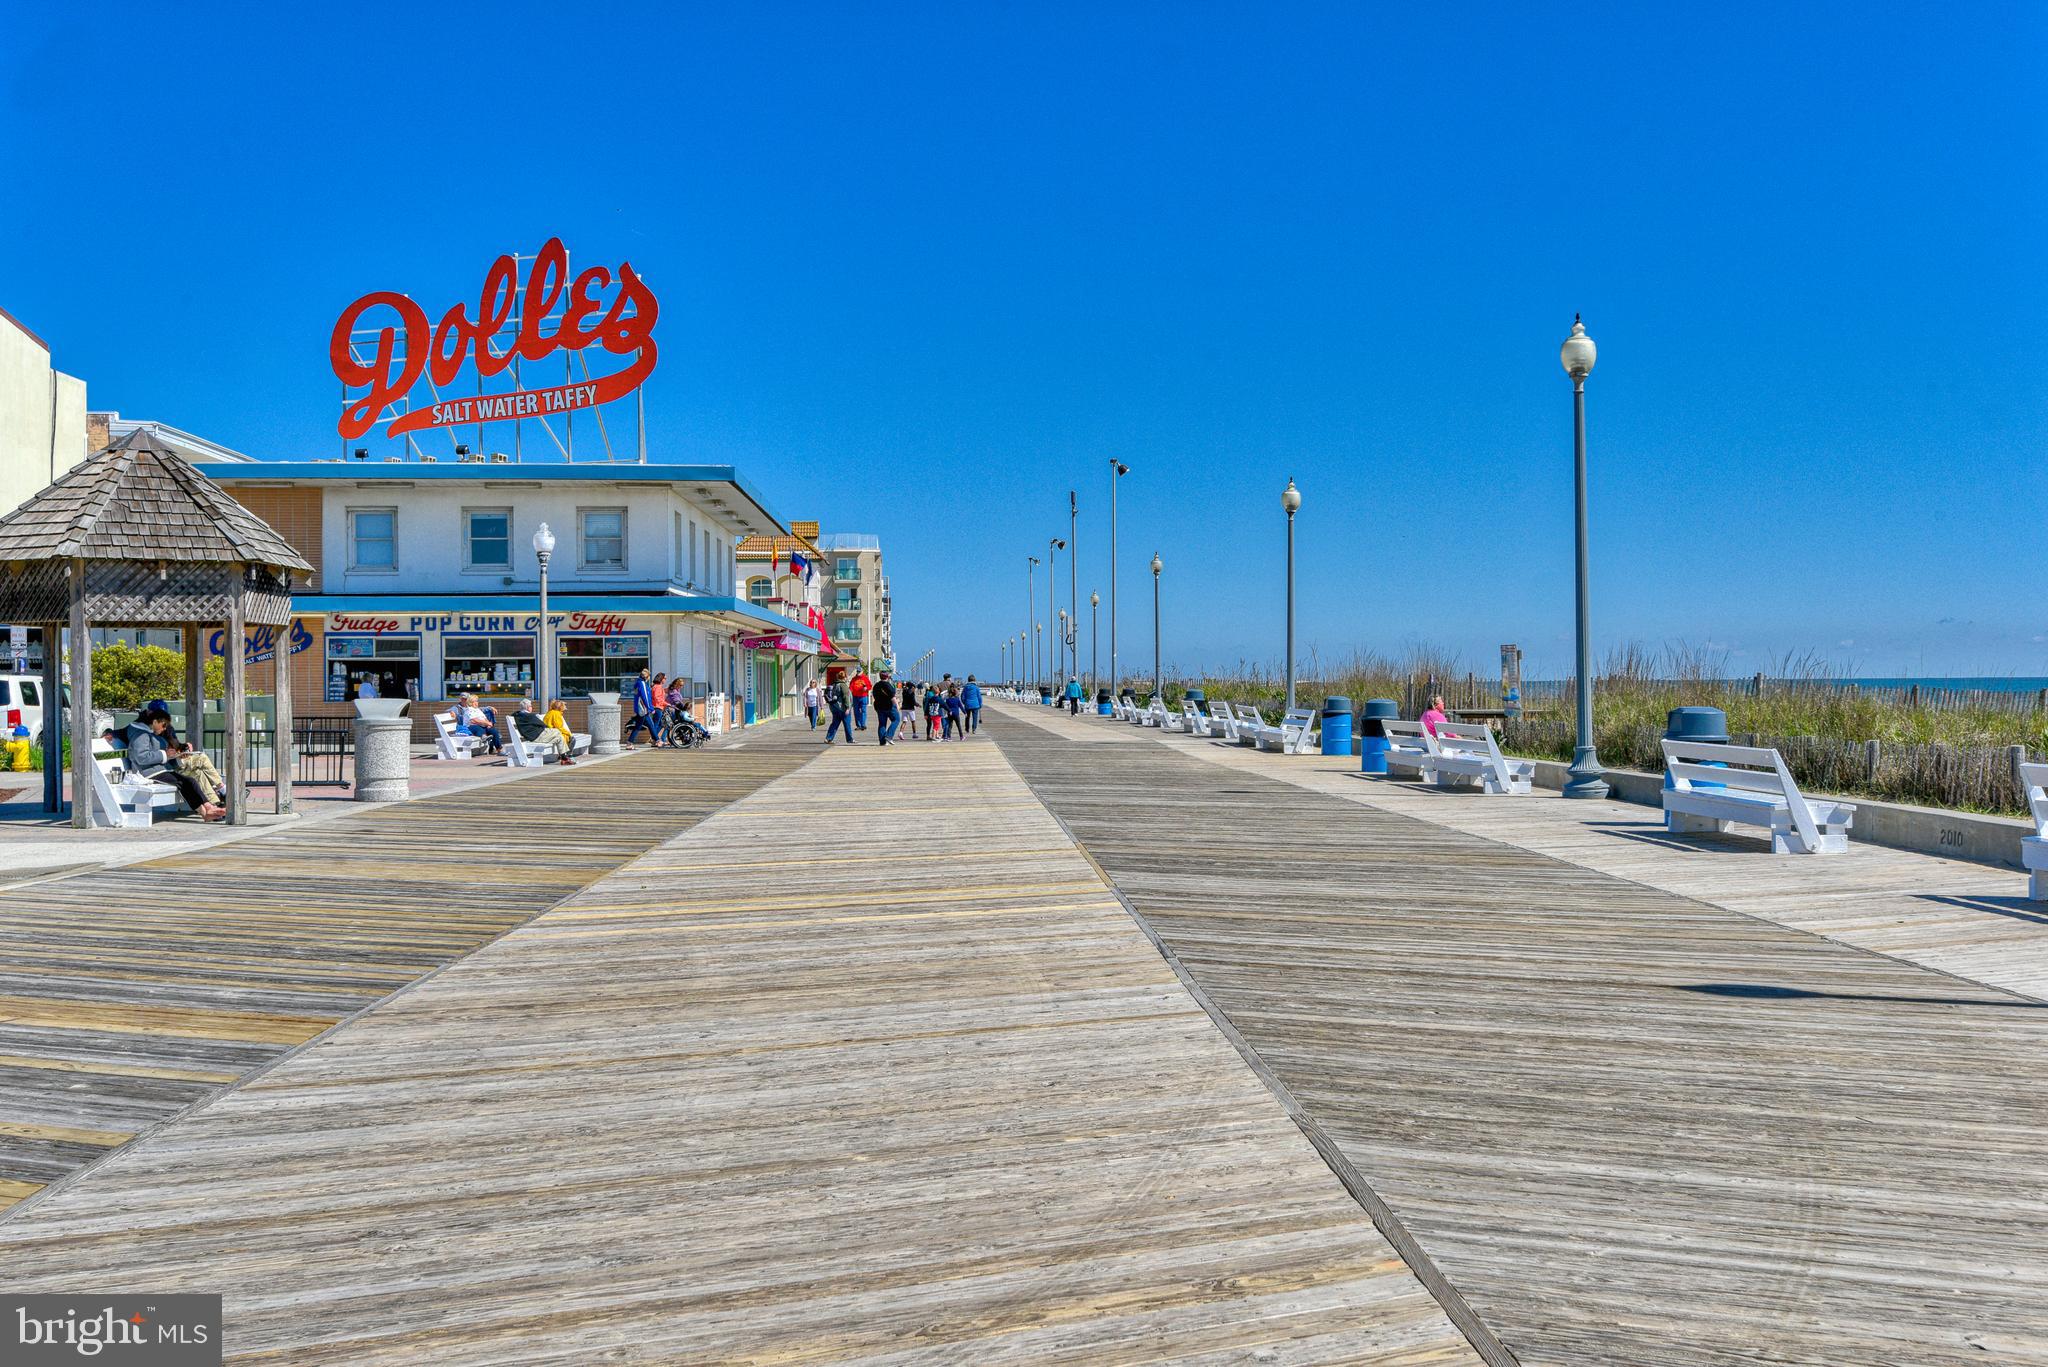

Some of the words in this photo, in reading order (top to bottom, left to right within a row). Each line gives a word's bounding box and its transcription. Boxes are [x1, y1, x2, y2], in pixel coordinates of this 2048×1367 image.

[432, 401, 473, 425] SALT
[476, 394, 539, 419] WATER
[541, 384, 598, 410] TAFFY
[331, 614, 400, 636] Fudge
[569, 612, 627, 636] Taffy
[256, 651, 275, 661] WATE
[1940, 829, 1963, 848] 2010
